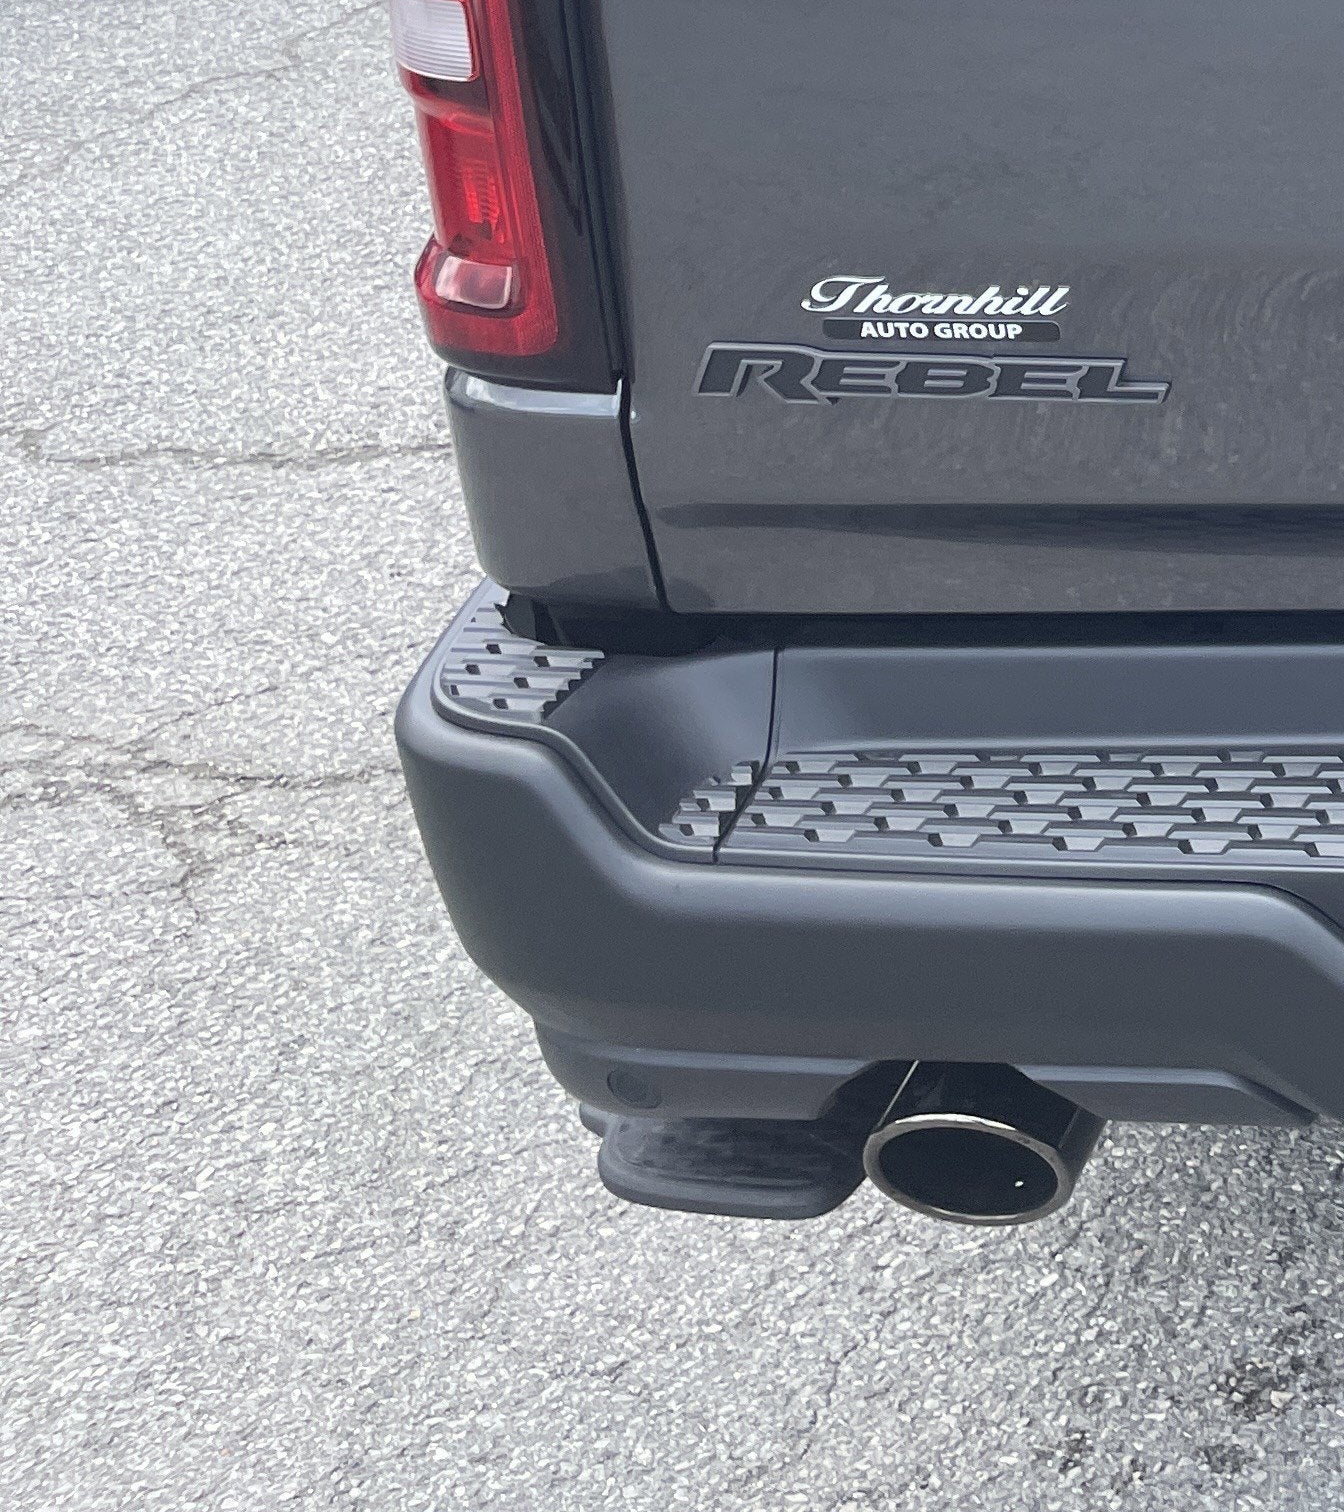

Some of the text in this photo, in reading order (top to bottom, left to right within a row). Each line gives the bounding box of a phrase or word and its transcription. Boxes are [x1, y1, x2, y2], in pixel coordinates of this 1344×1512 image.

[801, 275, 1071, 317] Thornhill
[860, 321, 1023, 340] AUTO GROUP
[692, 342, 1174, 405] REBEL
